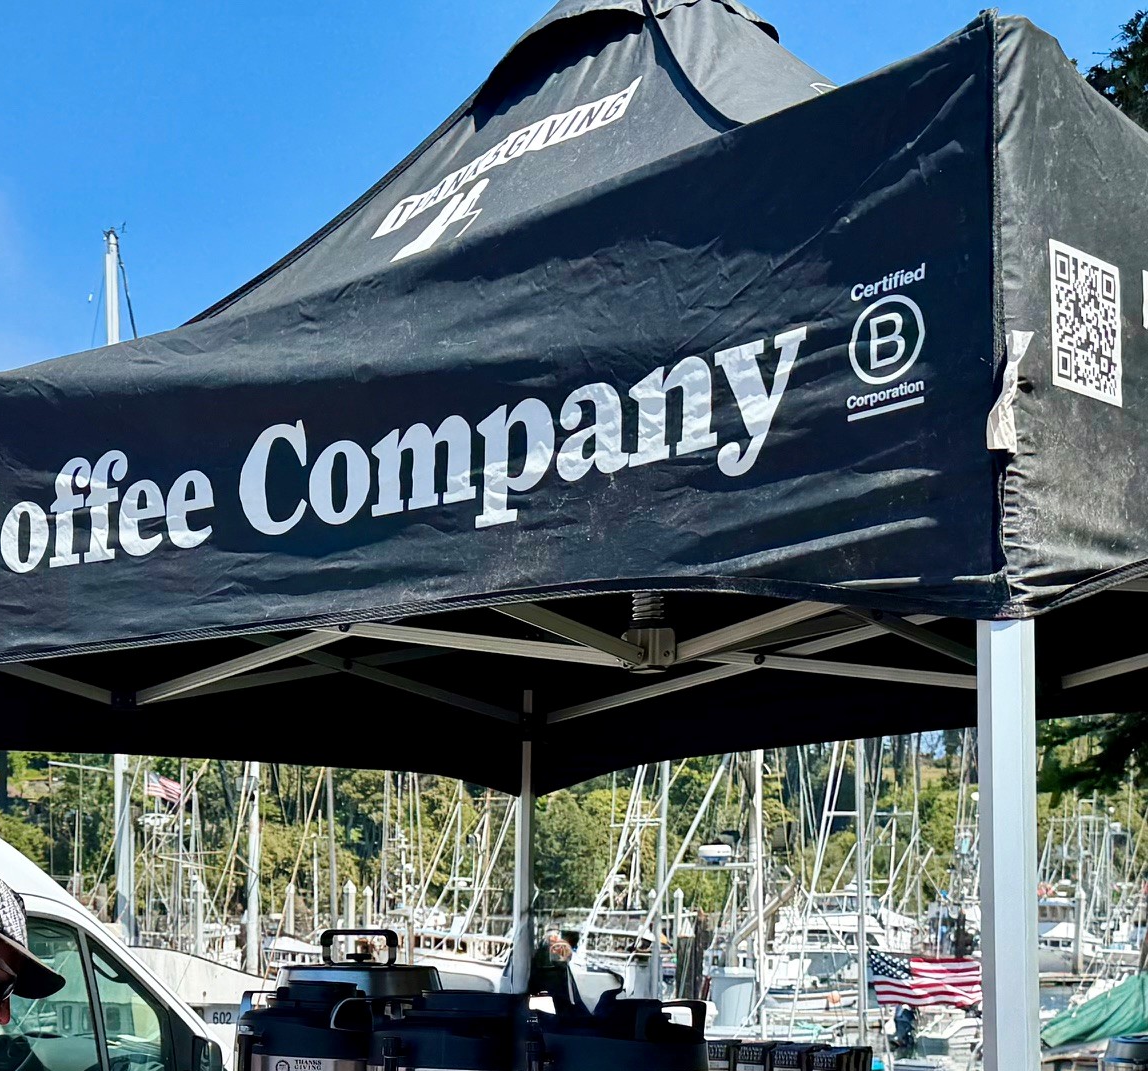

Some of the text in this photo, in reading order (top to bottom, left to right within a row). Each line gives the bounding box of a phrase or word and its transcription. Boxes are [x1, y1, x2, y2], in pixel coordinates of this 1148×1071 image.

[850, 262, 926, 302] Certified
[846, 380, 924, 410] Corporation
[238, 326, 808, 536] Company
[212, 1011, 232, 1025] 602
